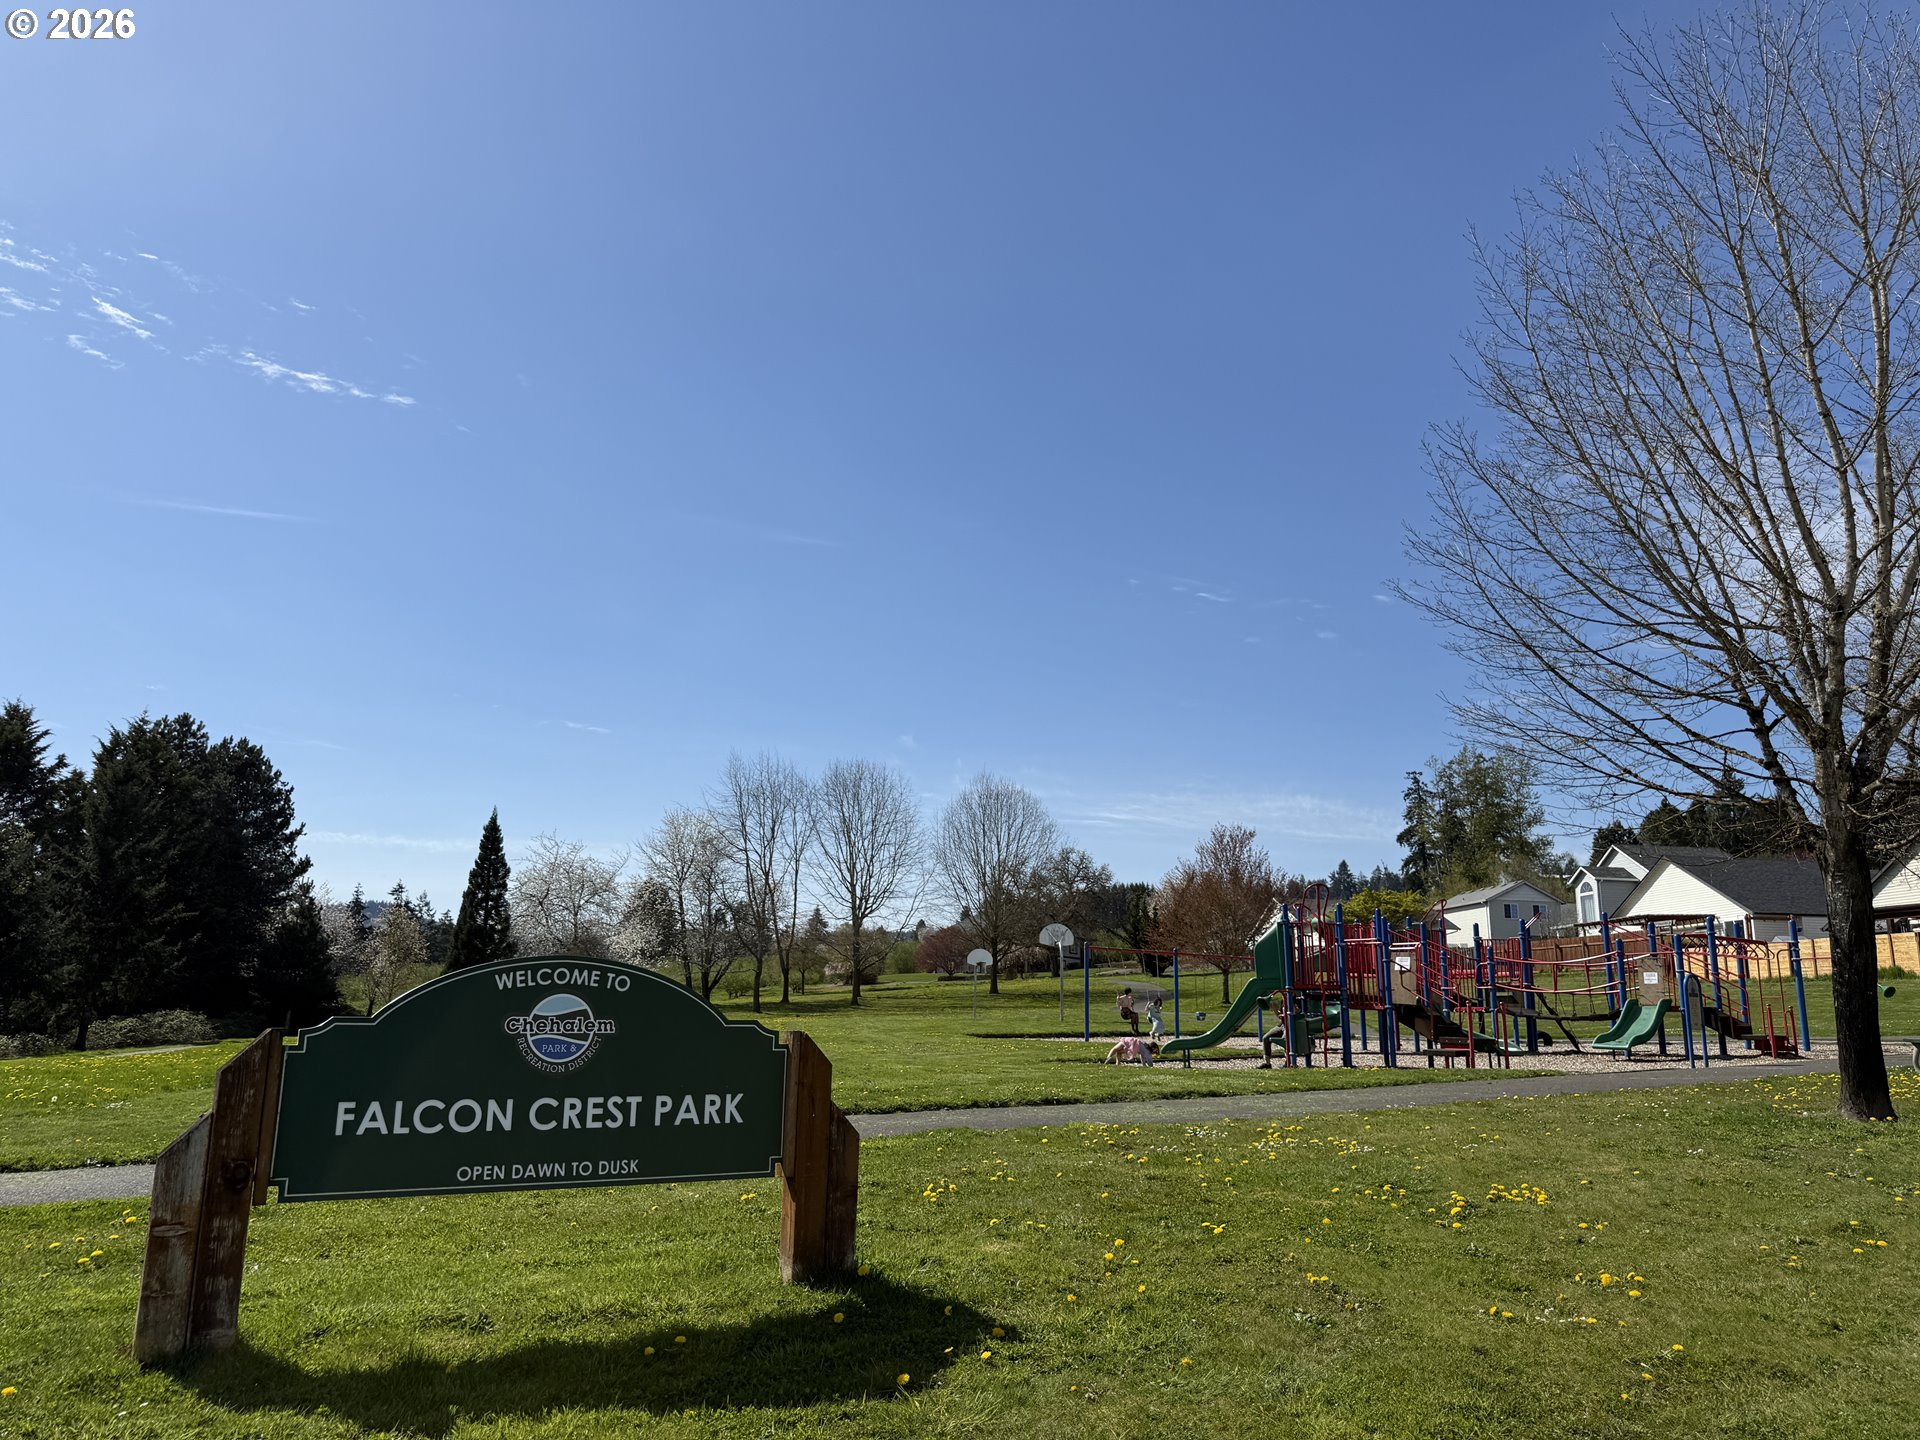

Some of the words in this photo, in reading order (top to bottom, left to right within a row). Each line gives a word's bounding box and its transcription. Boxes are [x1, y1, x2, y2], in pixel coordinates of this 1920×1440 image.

[494, 967, 601, 991] WELCOME
[606, 973, 631, 992] TO
[504, 1016, 616, 1034] Chehalem
[517, 1036, 565, 1073] RECREATION
[568, 1035, 602, 1071] DISTRICT
[541, 1044, 568, 1053] PARK
[569, 1044, 577, 1053] &
[335, 1098, 514, 1136] FALCON
[528, 1095, 643, 1131] CREST
[654, 1093, 744, 1127] PARK
[456, 1164, 506, 1182] OPEN
[511, 1162, 566, 1179] DAWN
[571, 1161, 593, 1177] TO
[598, 1159, 639, 1175] DUSK
